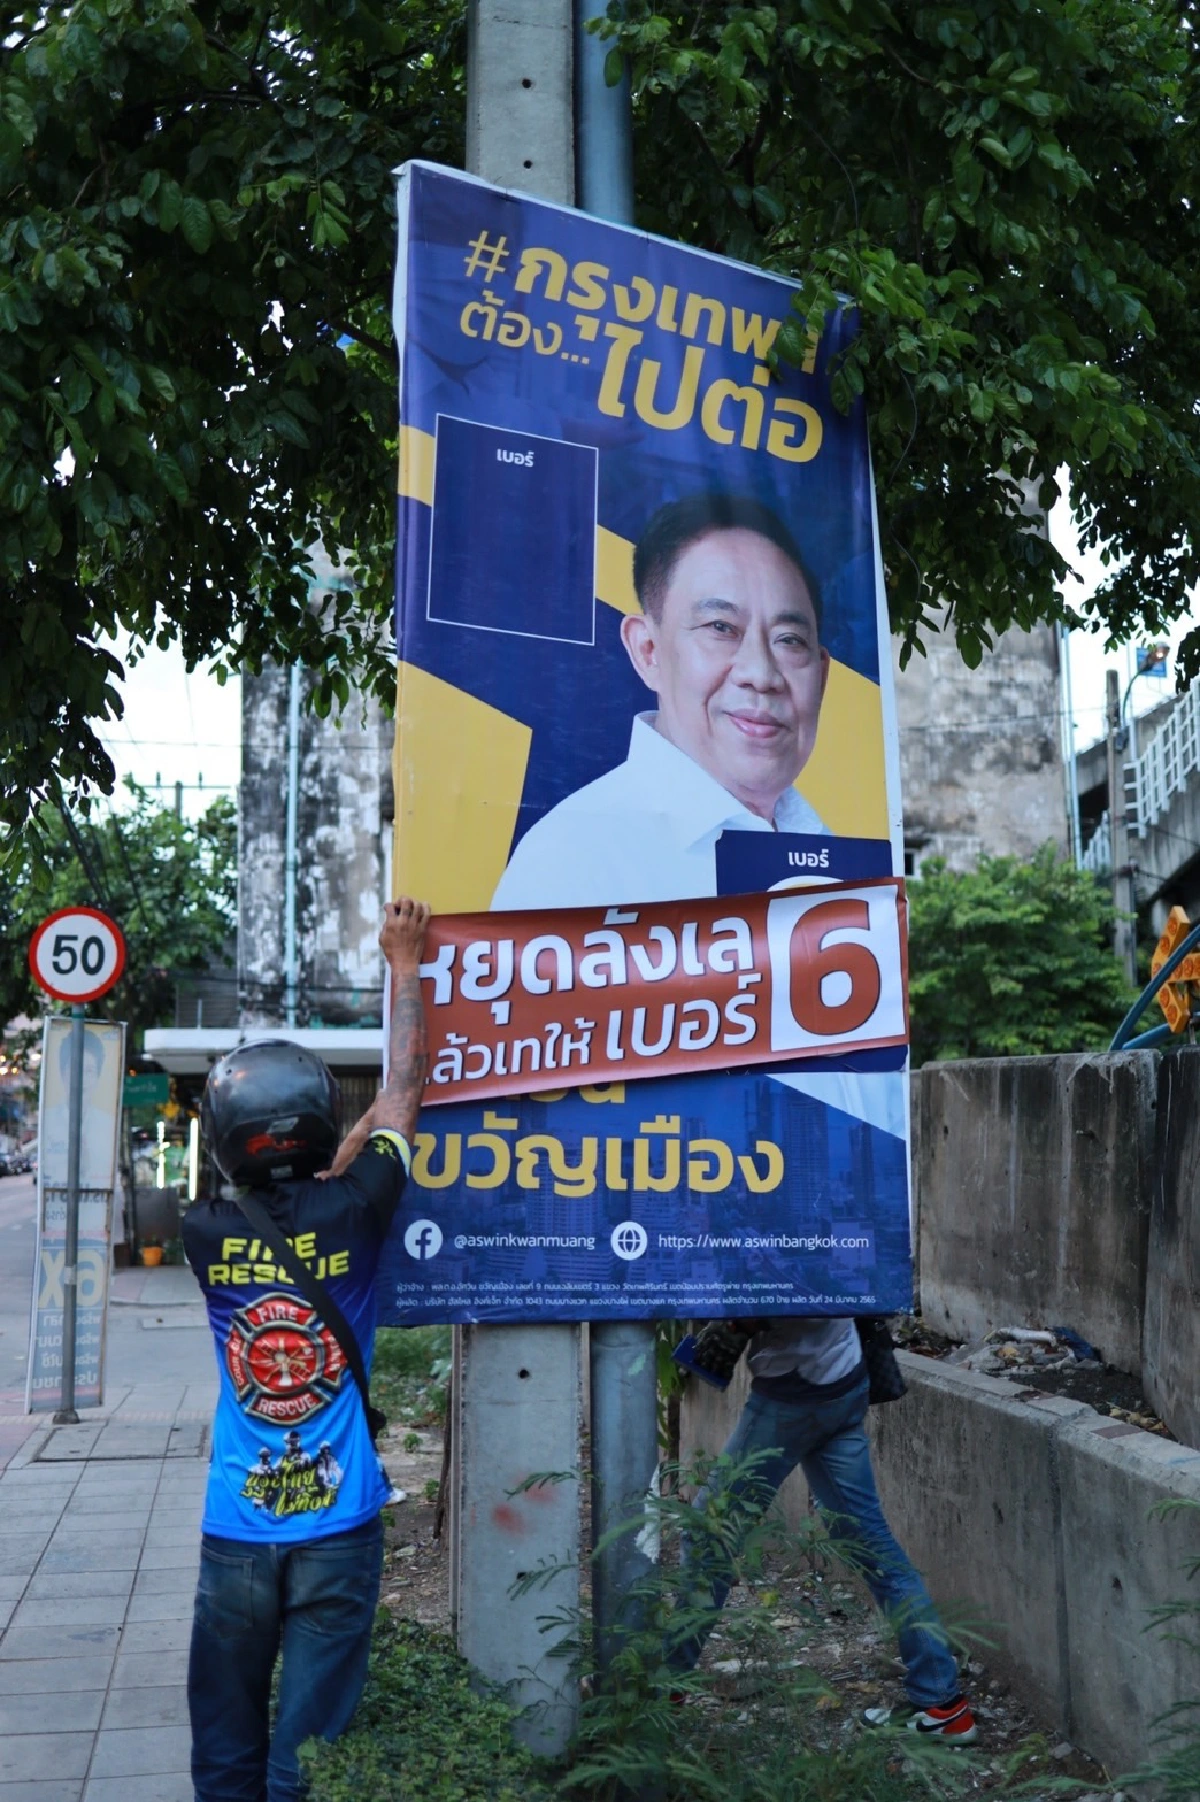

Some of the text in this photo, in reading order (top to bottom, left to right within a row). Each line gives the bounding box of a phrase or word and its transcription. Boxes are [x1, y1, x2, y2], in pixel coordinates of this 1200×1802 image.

[460, 290, 823, 463] ต้อง... ไปต่อ
[497, 448, 534, 468] เบอร์
[788, 849, 829, 868] เบอร์
[52, 934, 106, 976] 50
[425, 973, 762, 1085] ล้วเทให้ เบอร์
[411, 1110, 784, 1197] ขวัญเมือง
[454, 1234, 595, 1250] @aswinkwanmuang
[658, 1234, 869, 1250] https://www.aswinbangkok.com
[256, 1305, 300, 1323] FIRE
[259, 1394, 315, 1417] RESCUE
